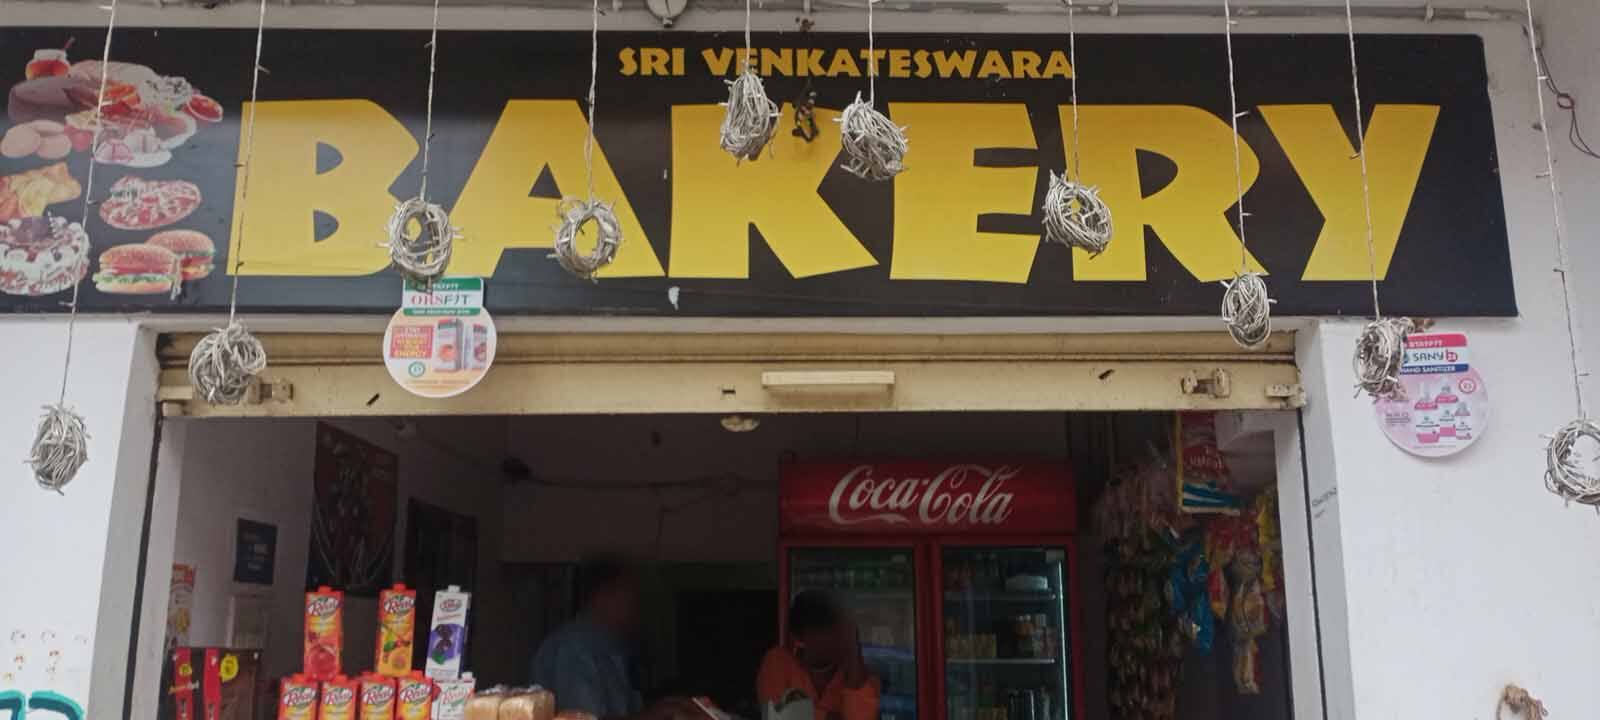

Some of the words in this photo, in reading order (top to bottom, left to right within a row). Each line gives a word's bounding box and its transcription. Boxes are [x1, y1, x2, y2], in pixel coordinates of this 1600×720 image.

[619, 47, 686, 77] SRI
[701, 47, 1074, 79] VENKATESWARA
[226, 99, 1441, 284] BAKERY
[828, 463, 1023, 525] Coca-Cola
